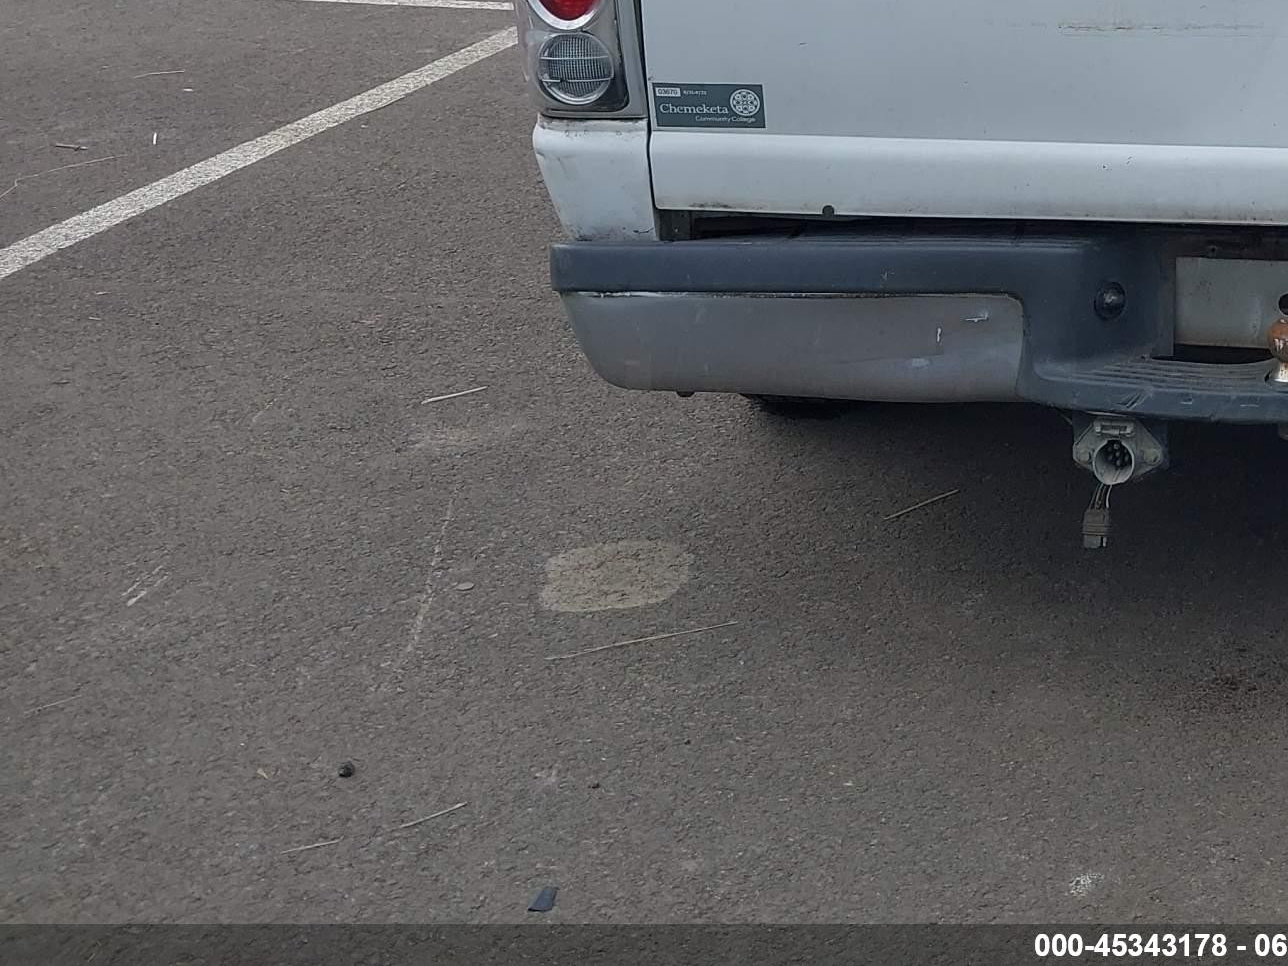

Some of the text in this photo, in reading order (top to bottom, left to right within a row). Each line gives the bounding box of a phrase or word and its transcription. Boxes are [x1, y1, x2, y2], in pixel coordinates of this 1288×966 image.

[659, 103, 729, 114] Chemeketa
[695, 115, 756, 123] Community College
